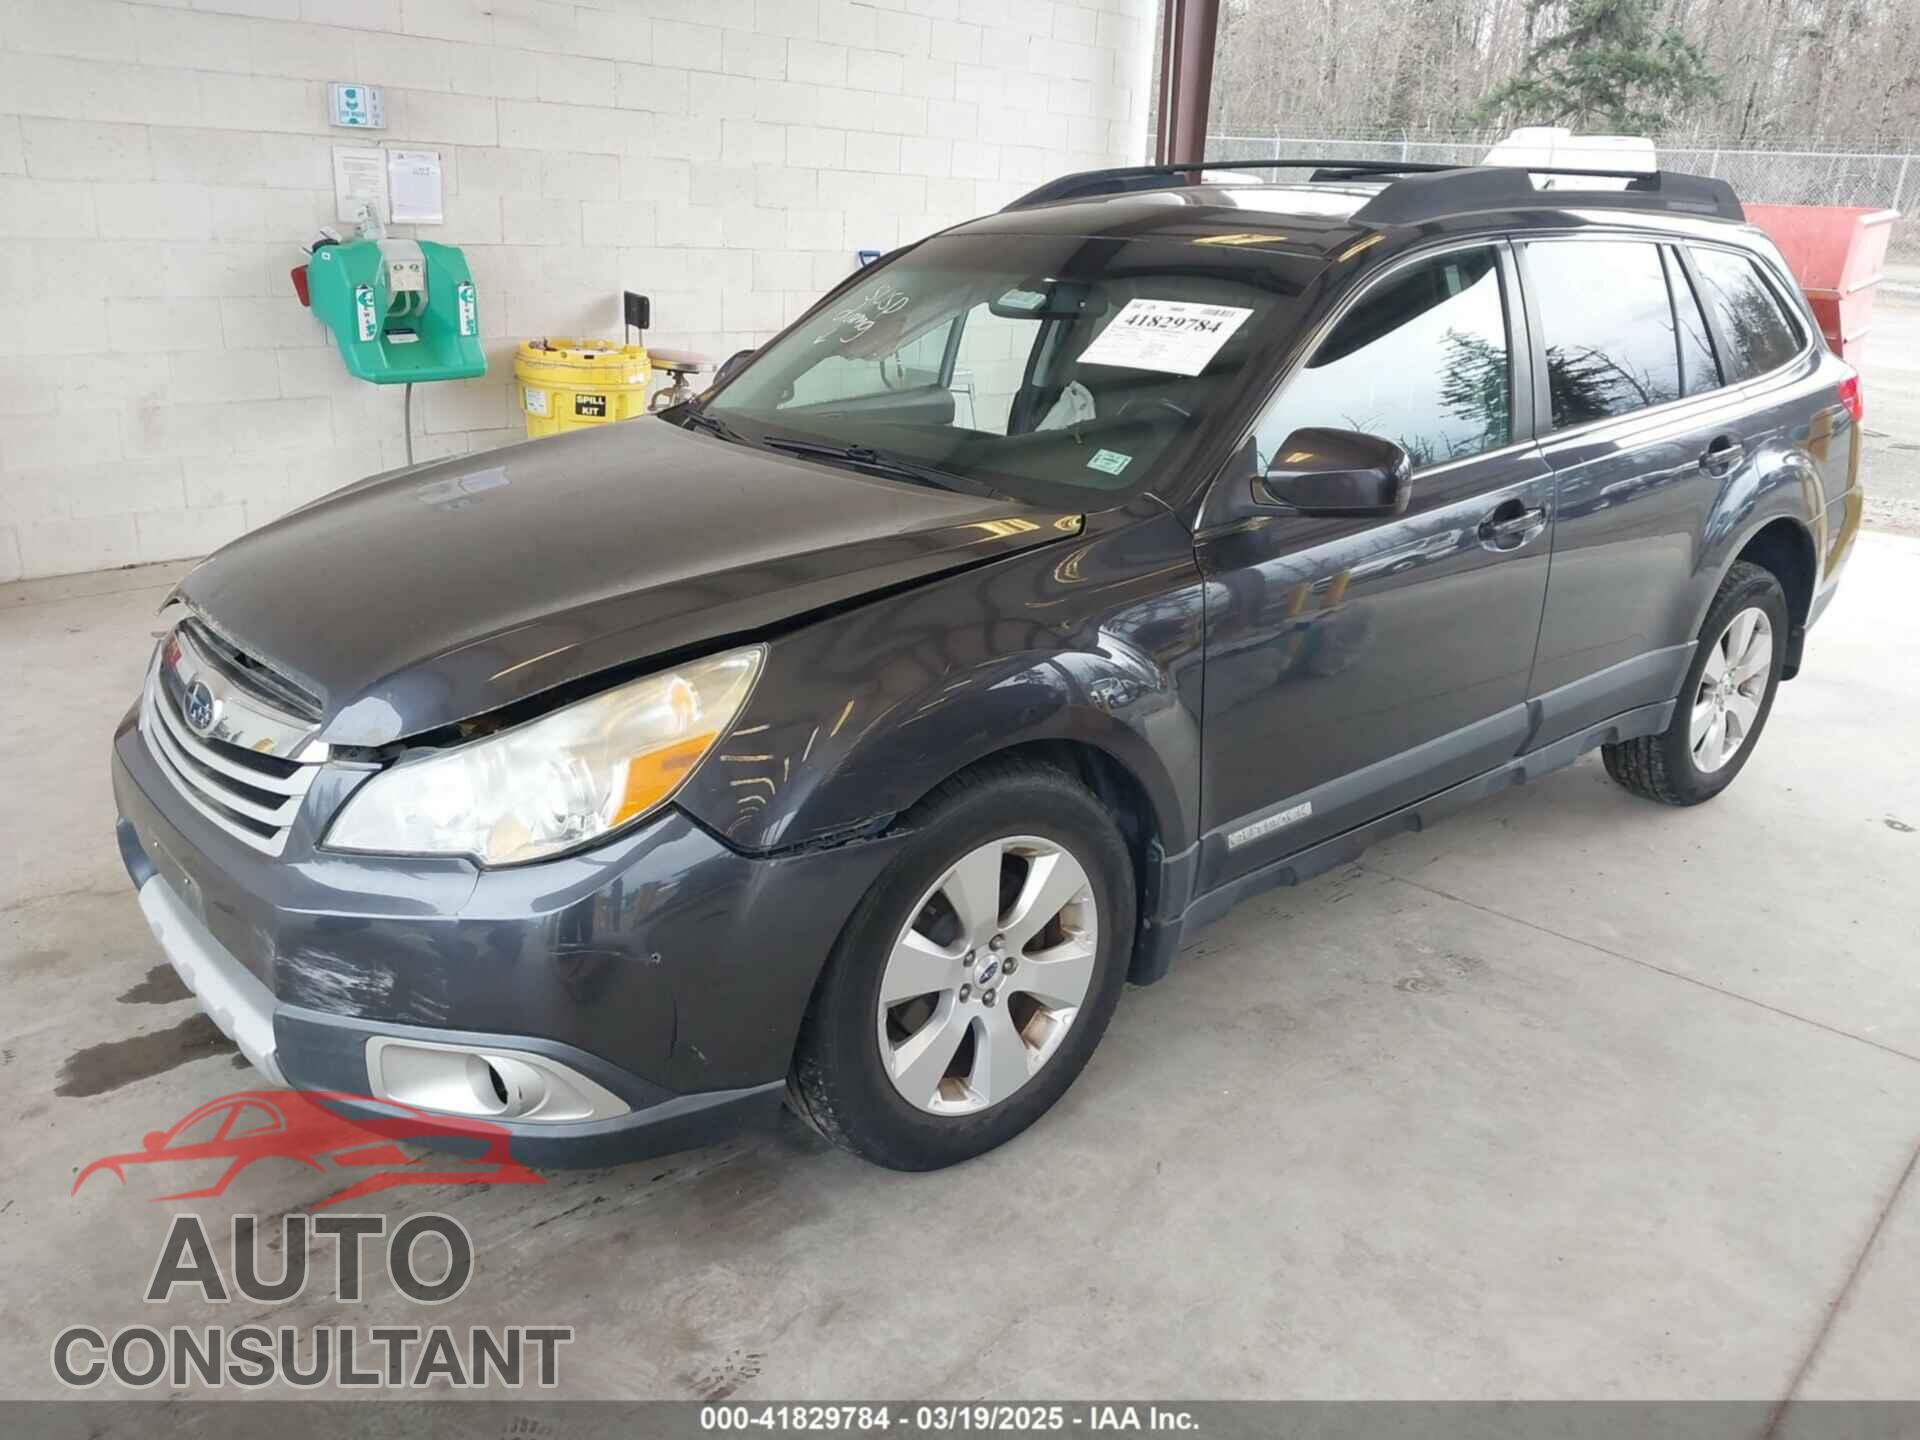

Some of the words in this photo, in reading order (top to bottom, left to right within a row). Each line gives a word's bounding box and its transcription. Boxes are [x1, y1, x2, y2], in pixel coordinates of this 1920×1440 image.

[1125, 313, 1224, 333] 41829784
[576, 395, 604, 405] SPILL
[582, 406, 600, 415] KIT
